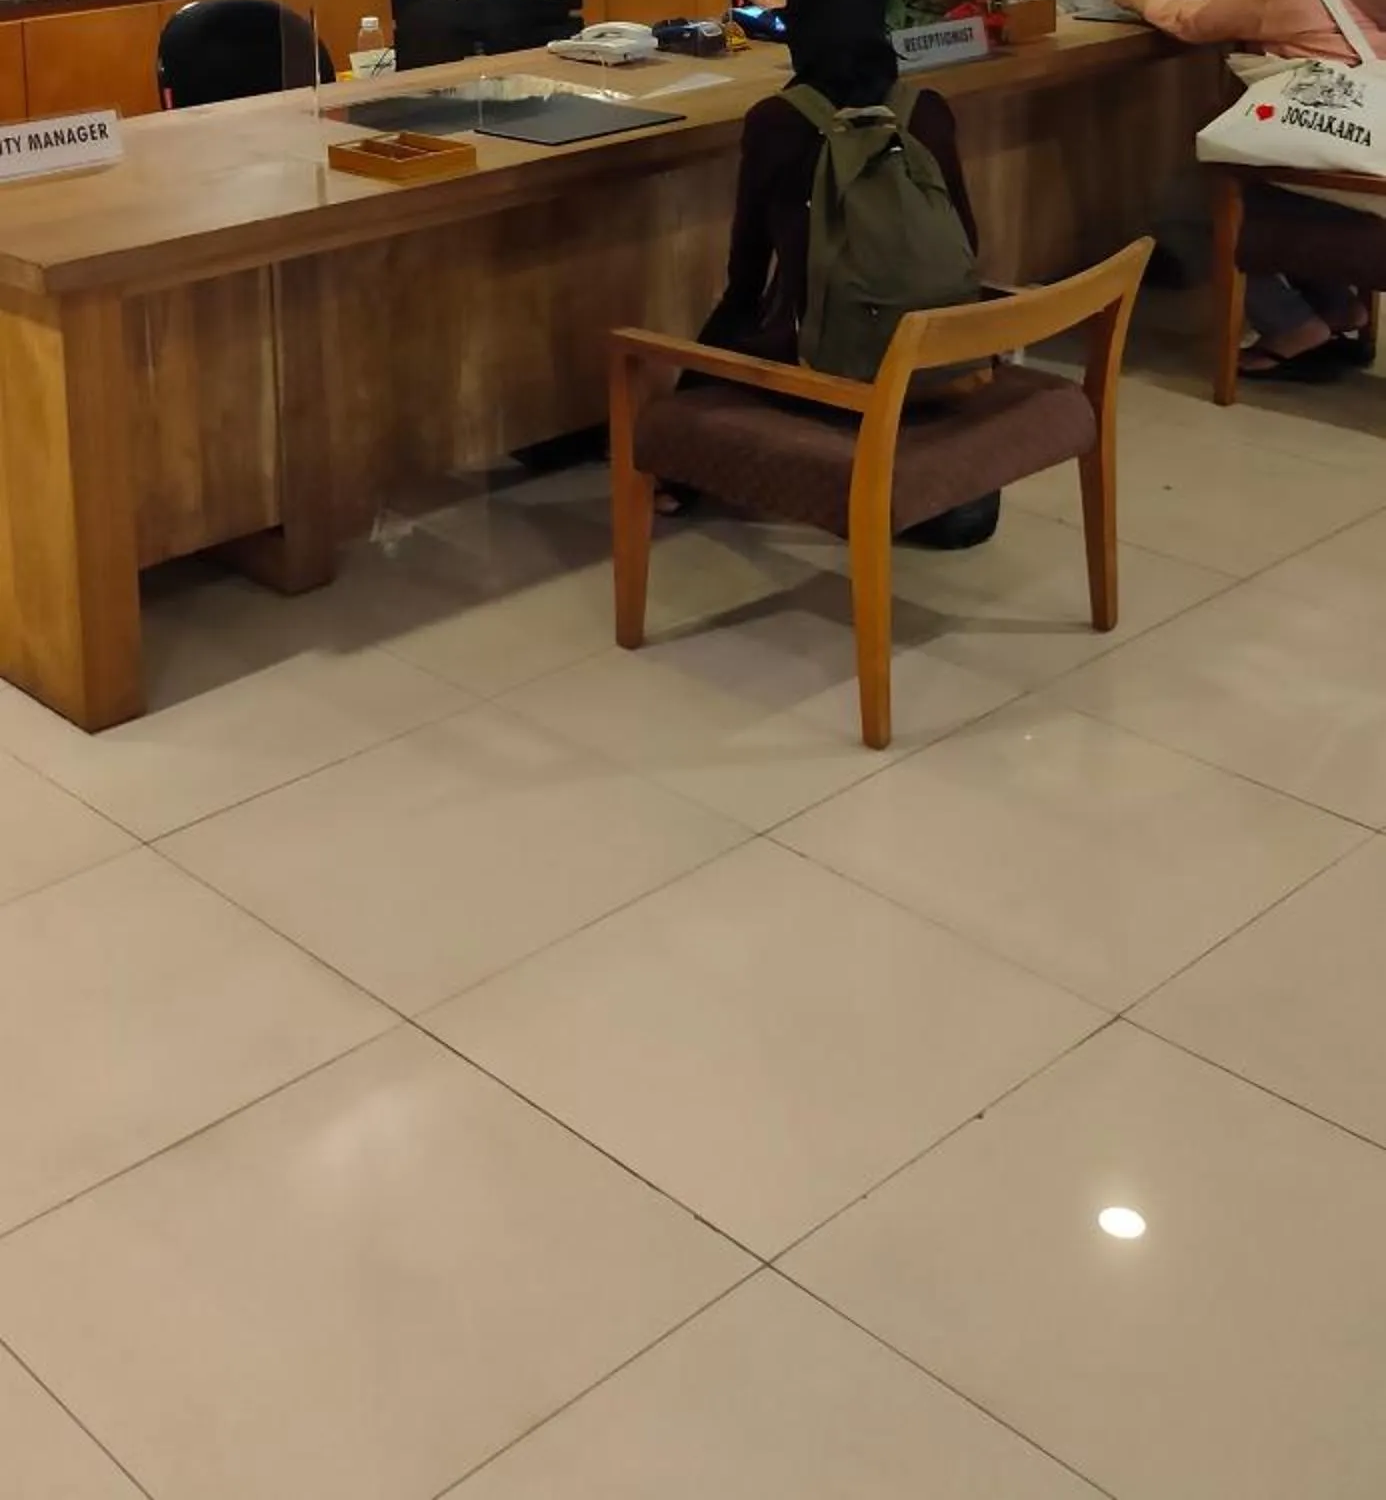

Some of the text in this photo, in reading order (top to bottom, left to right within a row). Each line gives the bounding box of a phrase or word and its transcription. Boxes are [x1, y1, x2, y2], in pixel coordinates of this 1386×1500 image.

[903, 26, 973, 53] RECEPTIONIST
[0, 122, 109, 156] TY MANAGER
[1281, 106, 1372, 147] JOGJAKARTA
